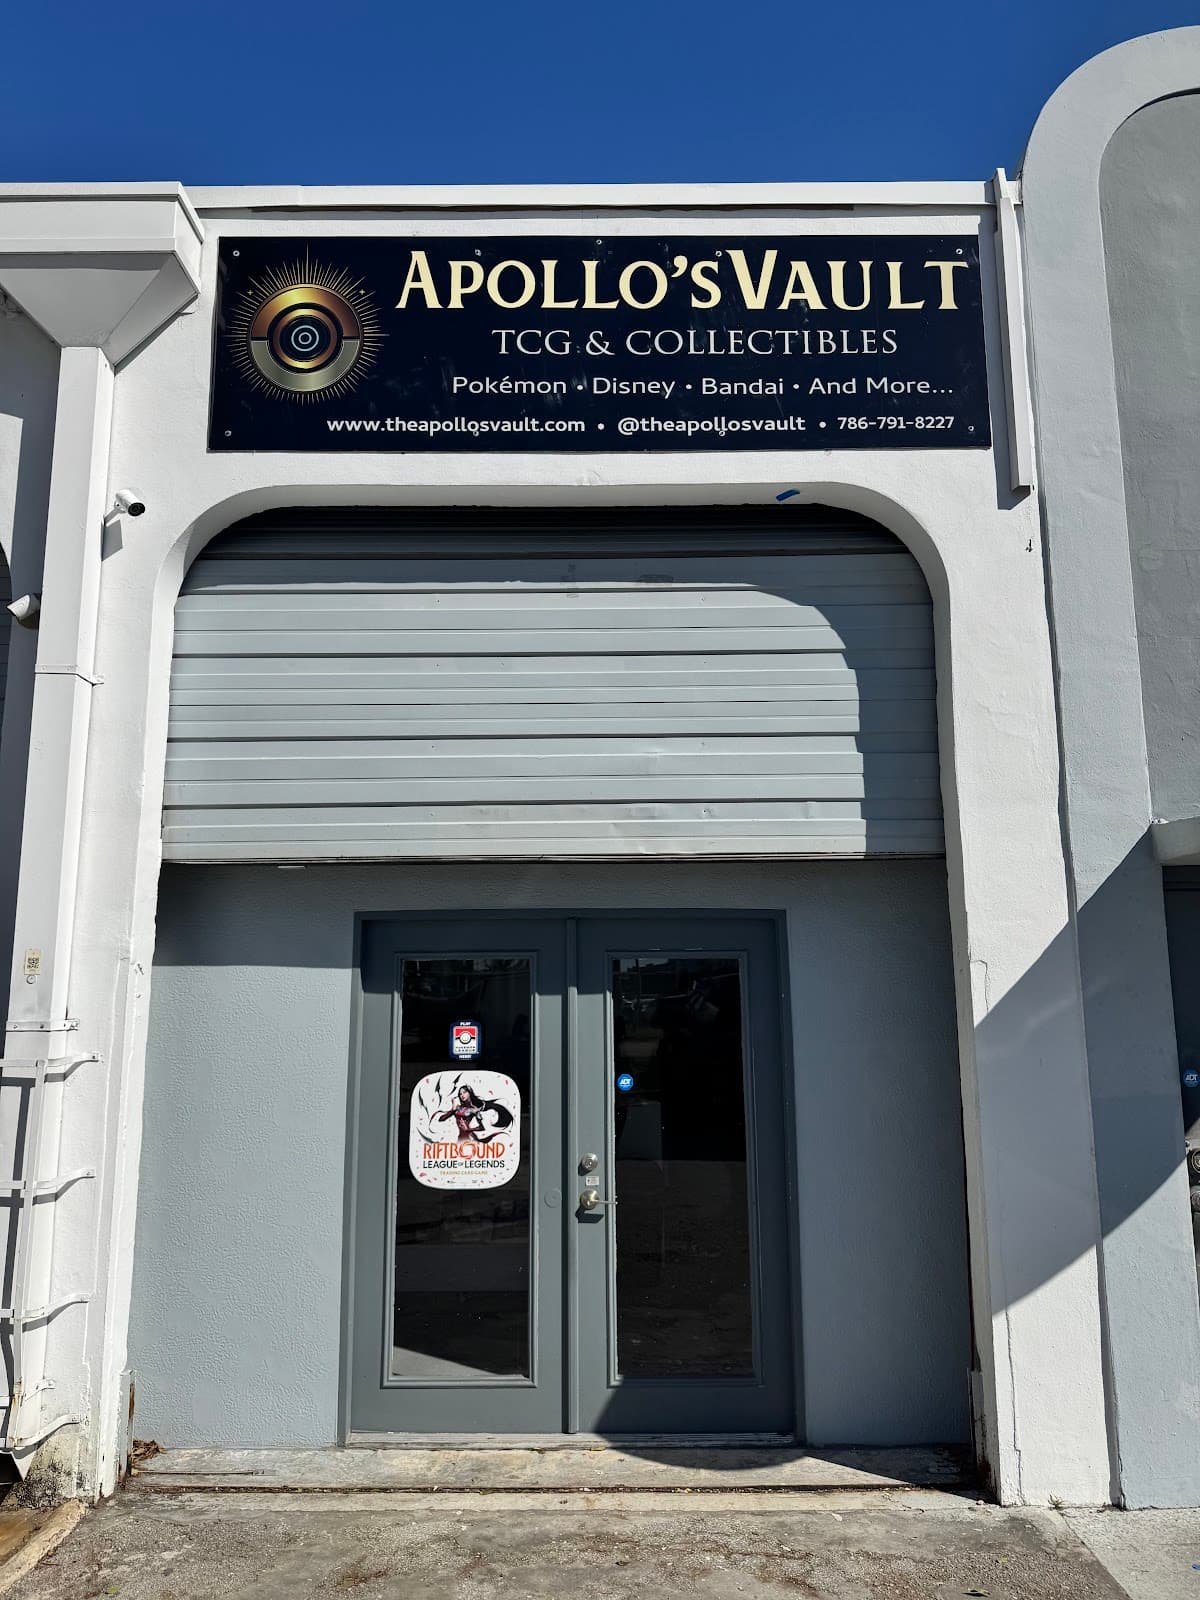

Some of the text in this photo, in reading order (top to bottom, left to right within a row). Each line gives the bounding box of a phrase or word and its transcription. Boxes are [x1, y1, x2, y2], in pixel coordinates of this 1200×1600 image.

[491, 329, 898, 356] TCG & COLLECTIBLES
[452, 375, 954, 400] Pokémon Disney Bandai And More...
[326, 415, 955, 436] www.theapollosvault.com @theapollosvault 786-791-8227
[423, 1142, 505, 1160] RIFTBOUND
[423, 1160, 458, 1169] LEAGUE
[464, 1160, 505, 1169] LEGENDS
